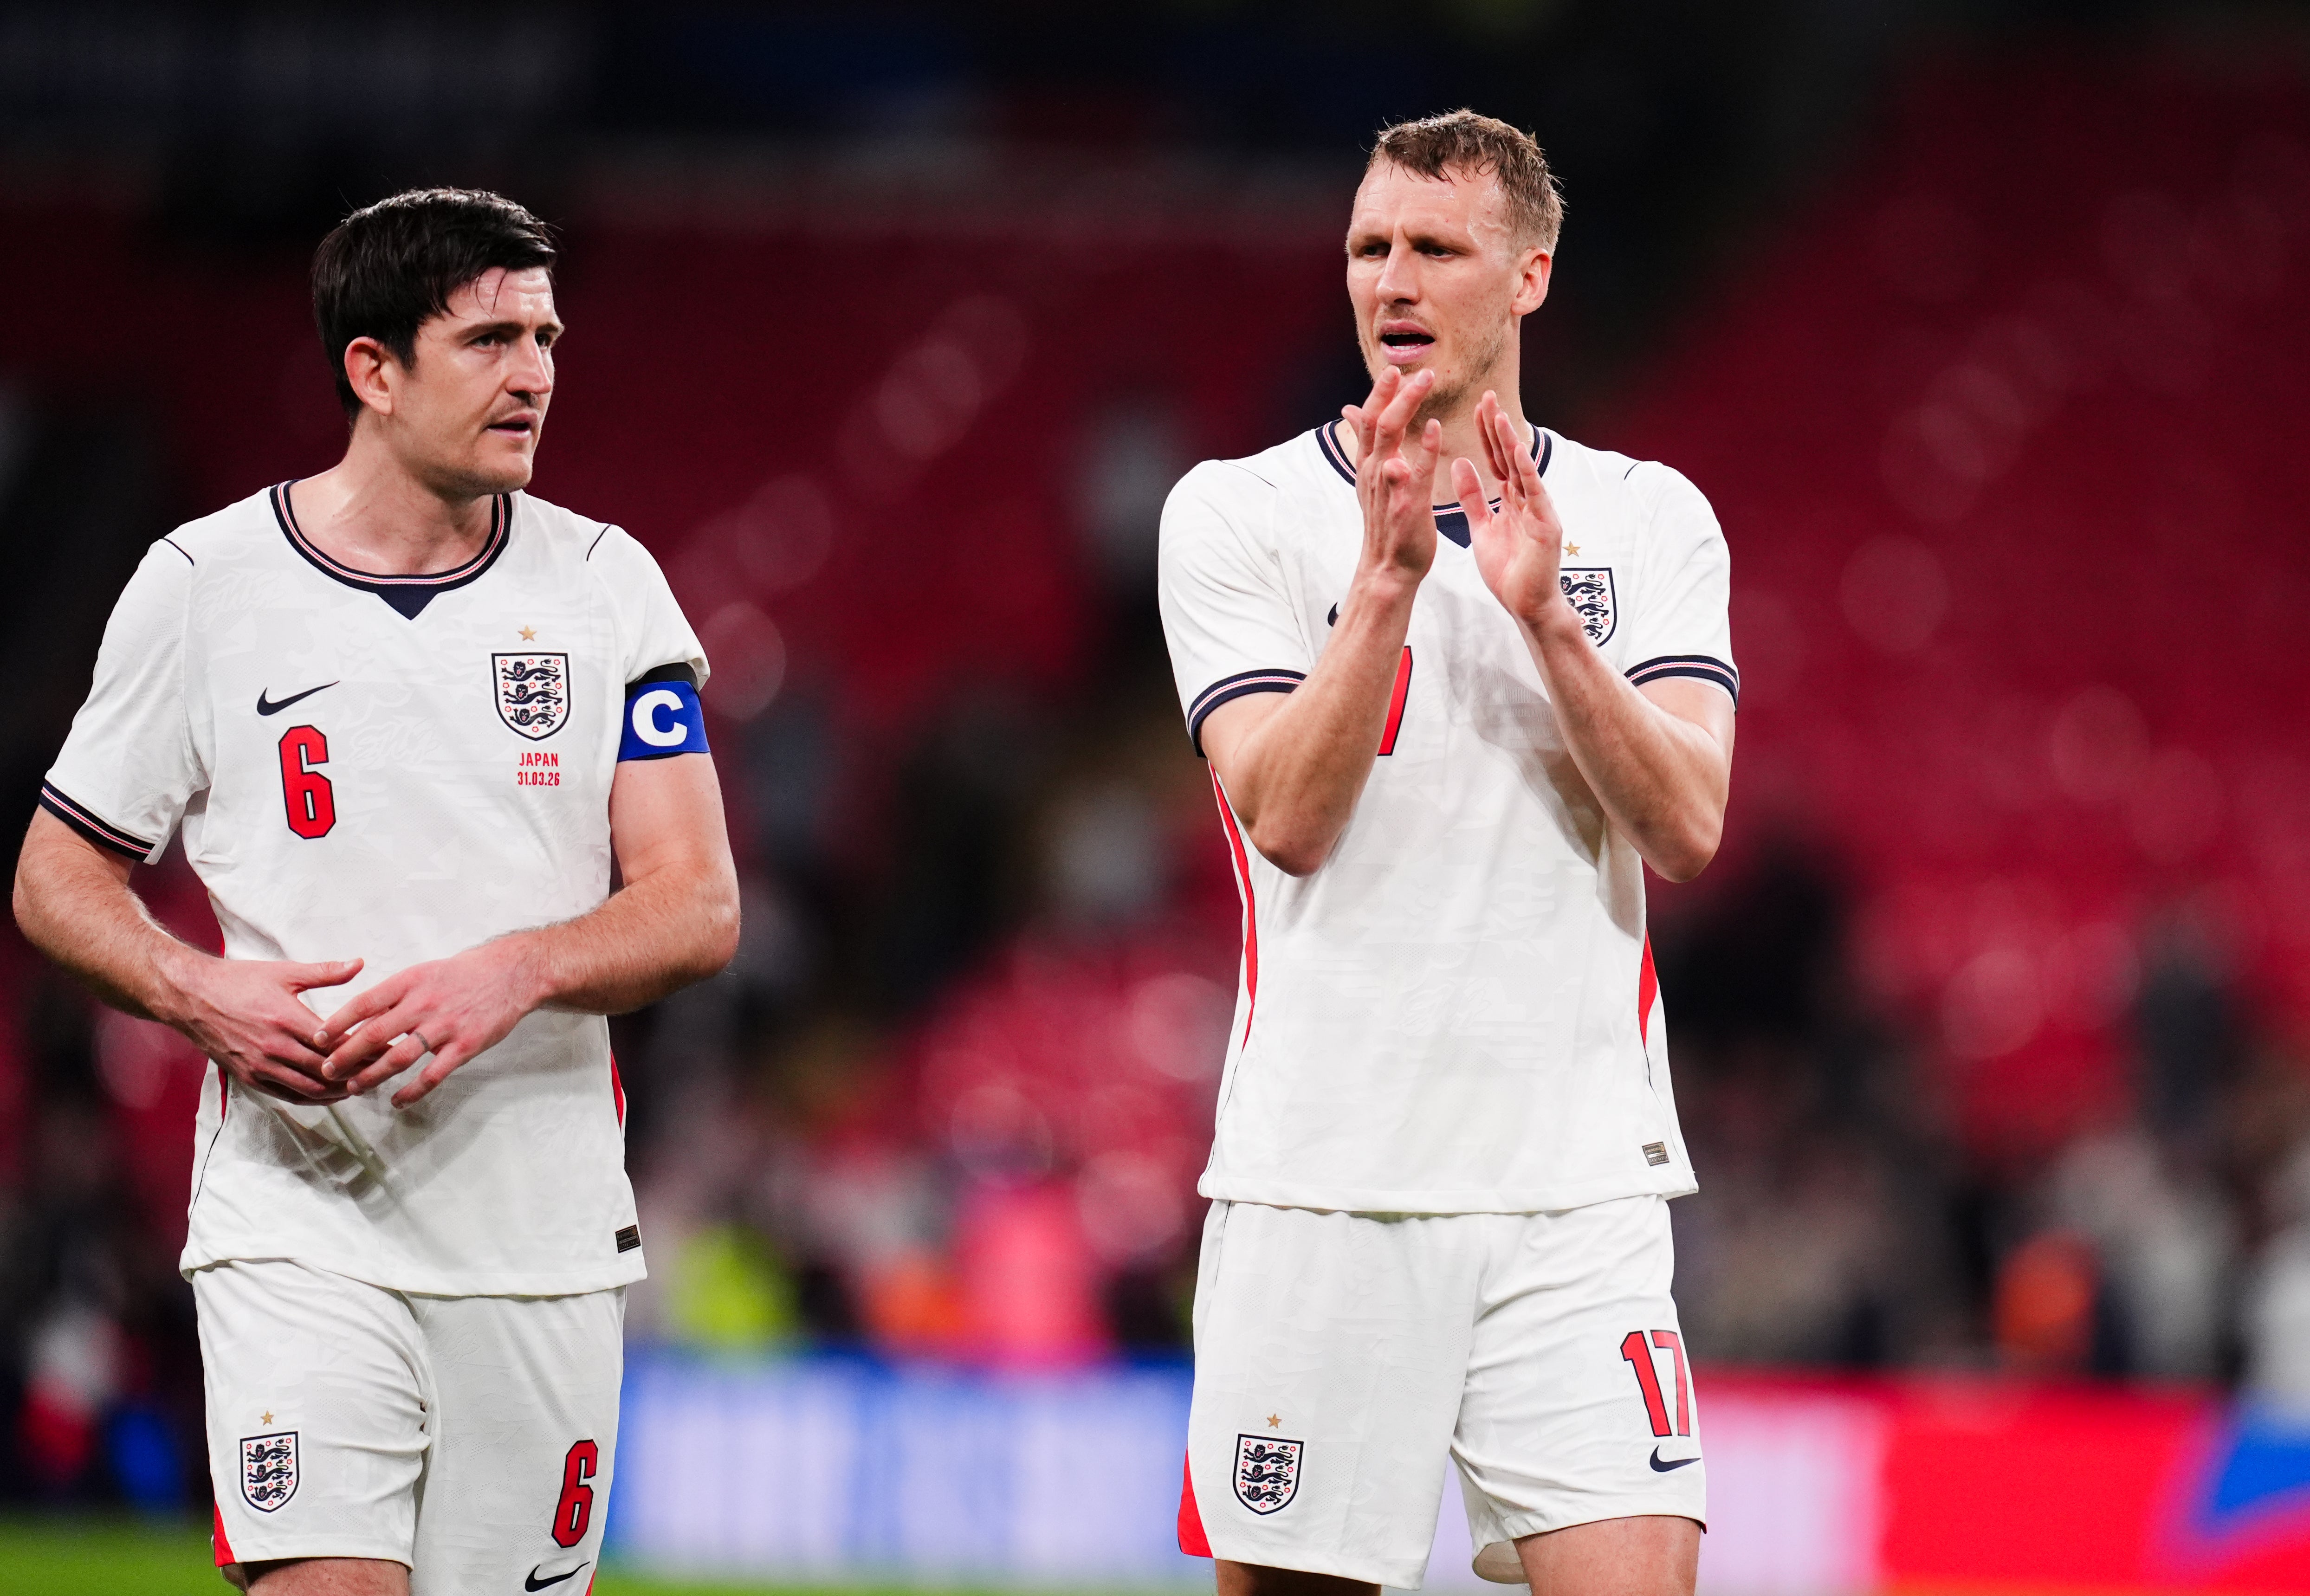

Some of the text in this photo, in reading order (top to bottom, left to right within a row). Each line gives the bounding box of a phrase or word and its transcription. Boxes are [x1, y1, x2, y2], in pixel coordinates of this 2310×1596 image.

[519, 752, 559, 767] JAPAN
[632, 690, 687, 747] C
[278, 724, 336, 840] 6
[518, 771, 560, 786] 31.03.26
[1620, 1329, 1690, 1437] 17
[551, 1439, 598, 1549] 6
